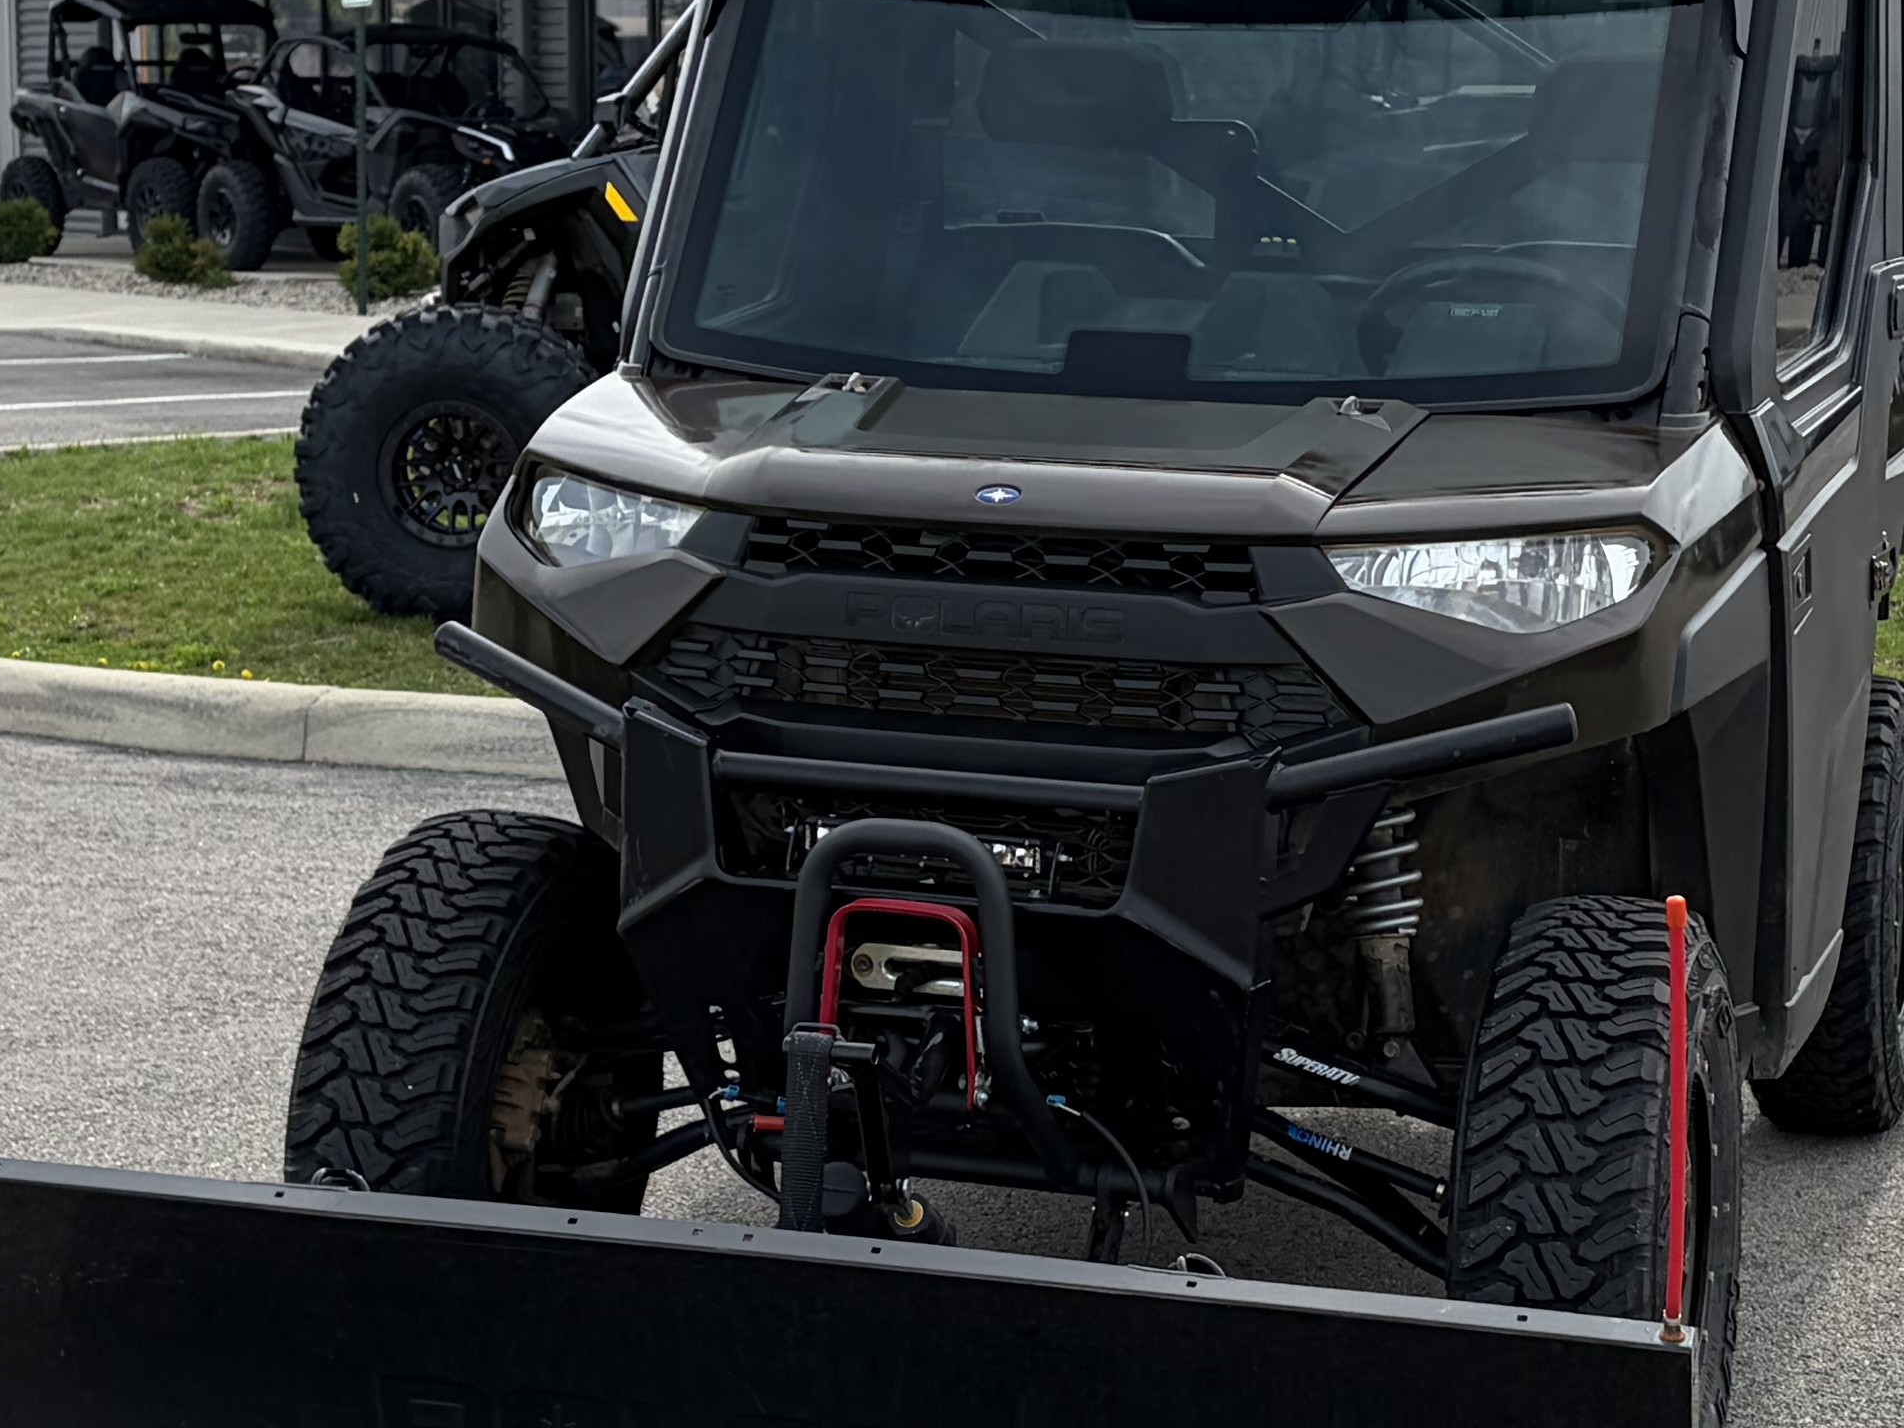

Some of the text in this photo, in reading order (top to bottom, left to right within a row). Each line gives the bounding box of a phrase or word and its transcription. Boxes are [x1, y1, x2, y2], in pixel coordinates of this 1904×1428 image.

[847, 590, 1127, 647] POLARIS
[1273, 1047, 1361, 1086] SUPERATV
[1296, 1127, 1354, 1162] RHINO
